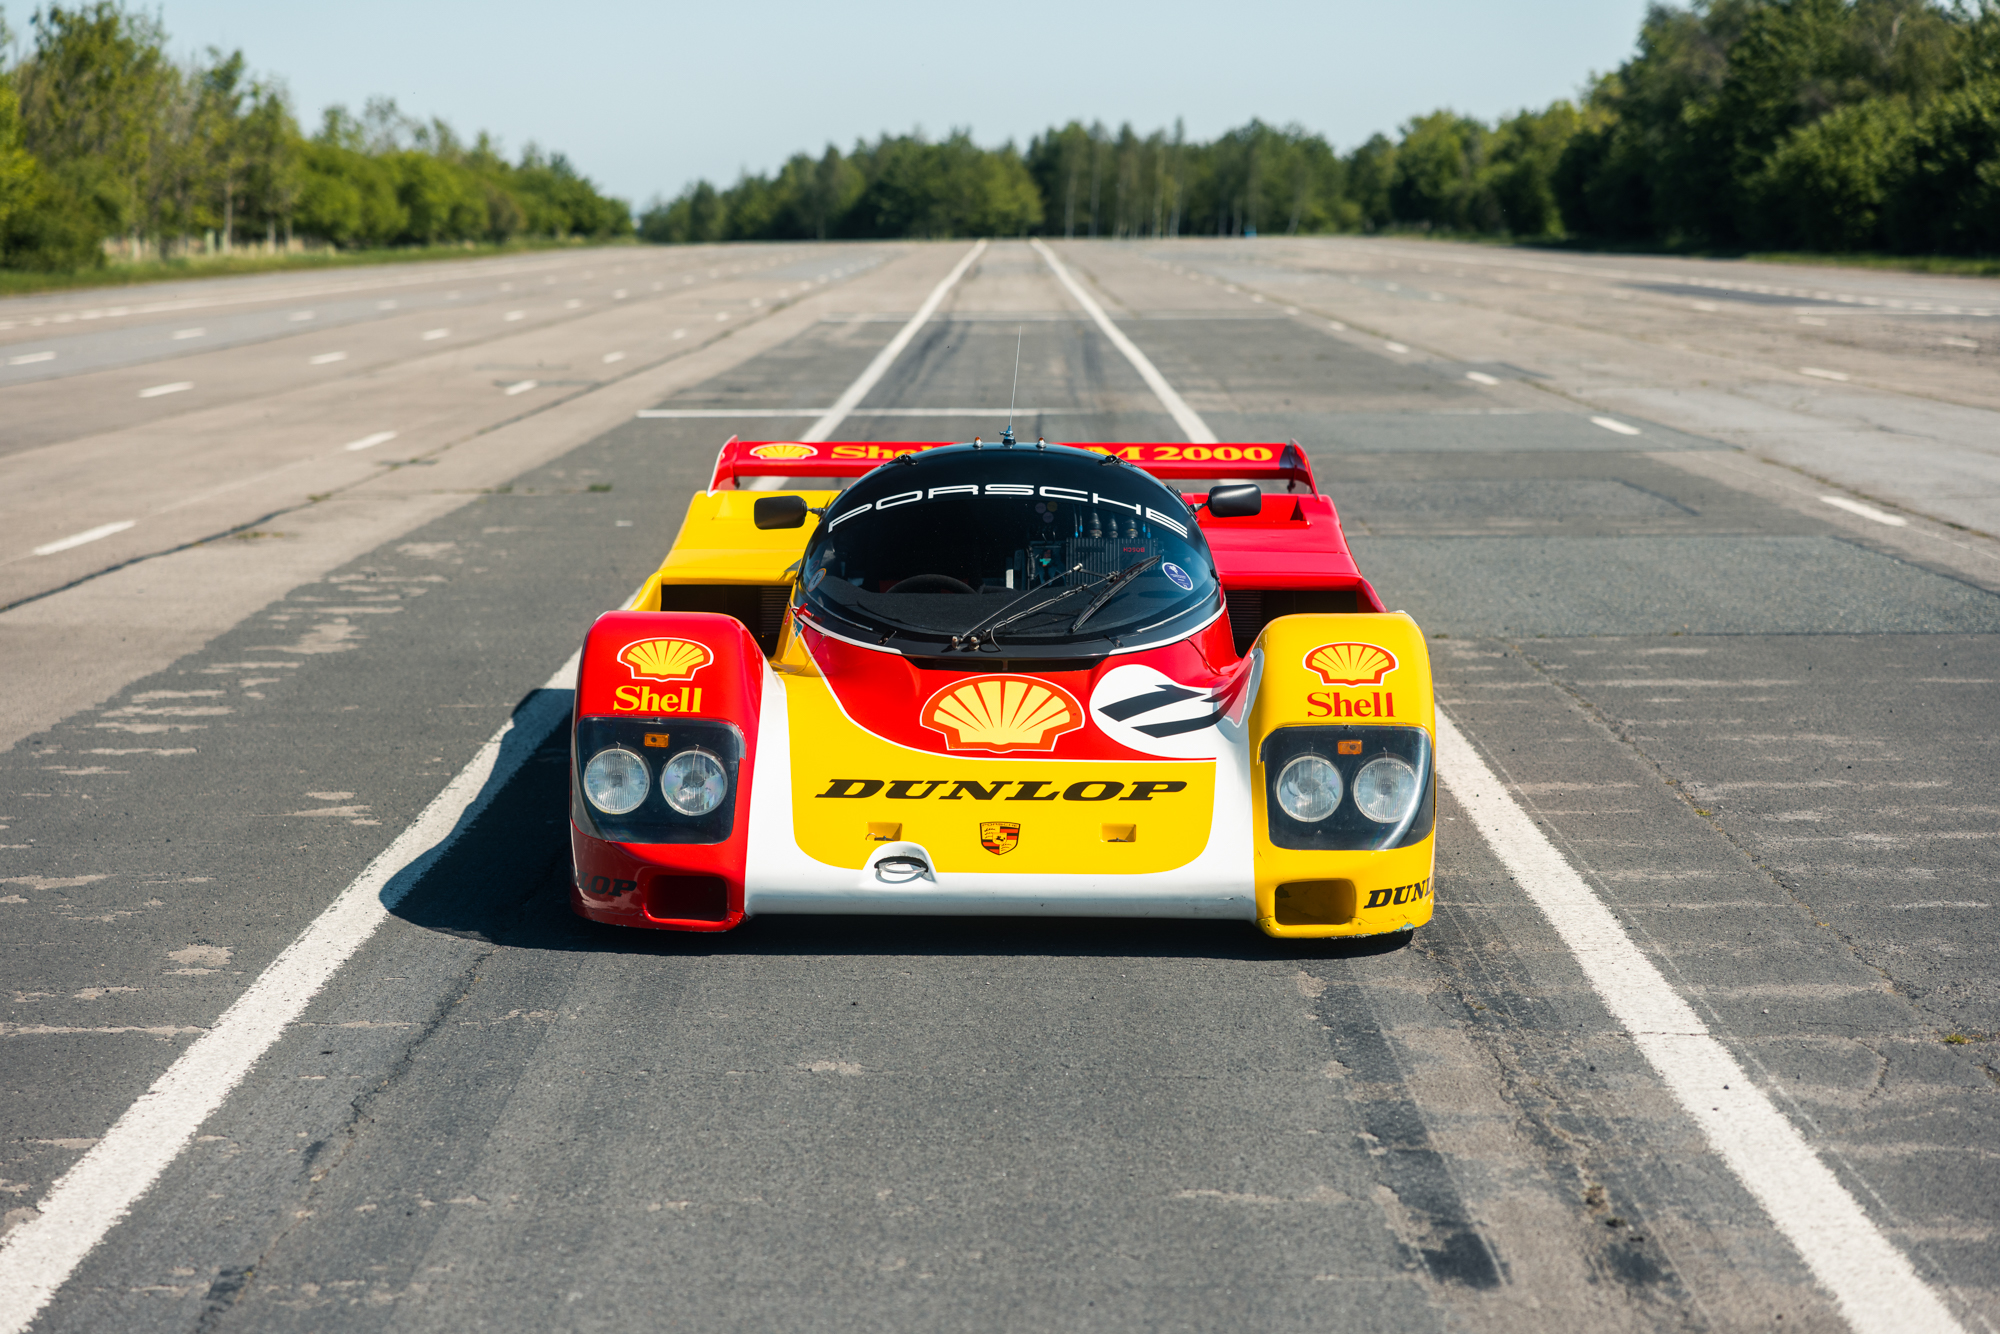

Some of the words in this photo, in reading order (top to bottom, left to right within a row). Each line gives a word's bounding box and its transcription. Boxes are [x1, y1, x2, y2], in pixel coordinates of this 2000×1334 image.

[1153, 446, 1274, 462] 2000
[828, 483, 1189, 540] PORSCHE
[613, 684, 703, 713] Shell
[1306, 691, 1397, 718] Shell
[814, 777, 1188, 802] DUNLOP
[575, 868, 638, 898] LOP
